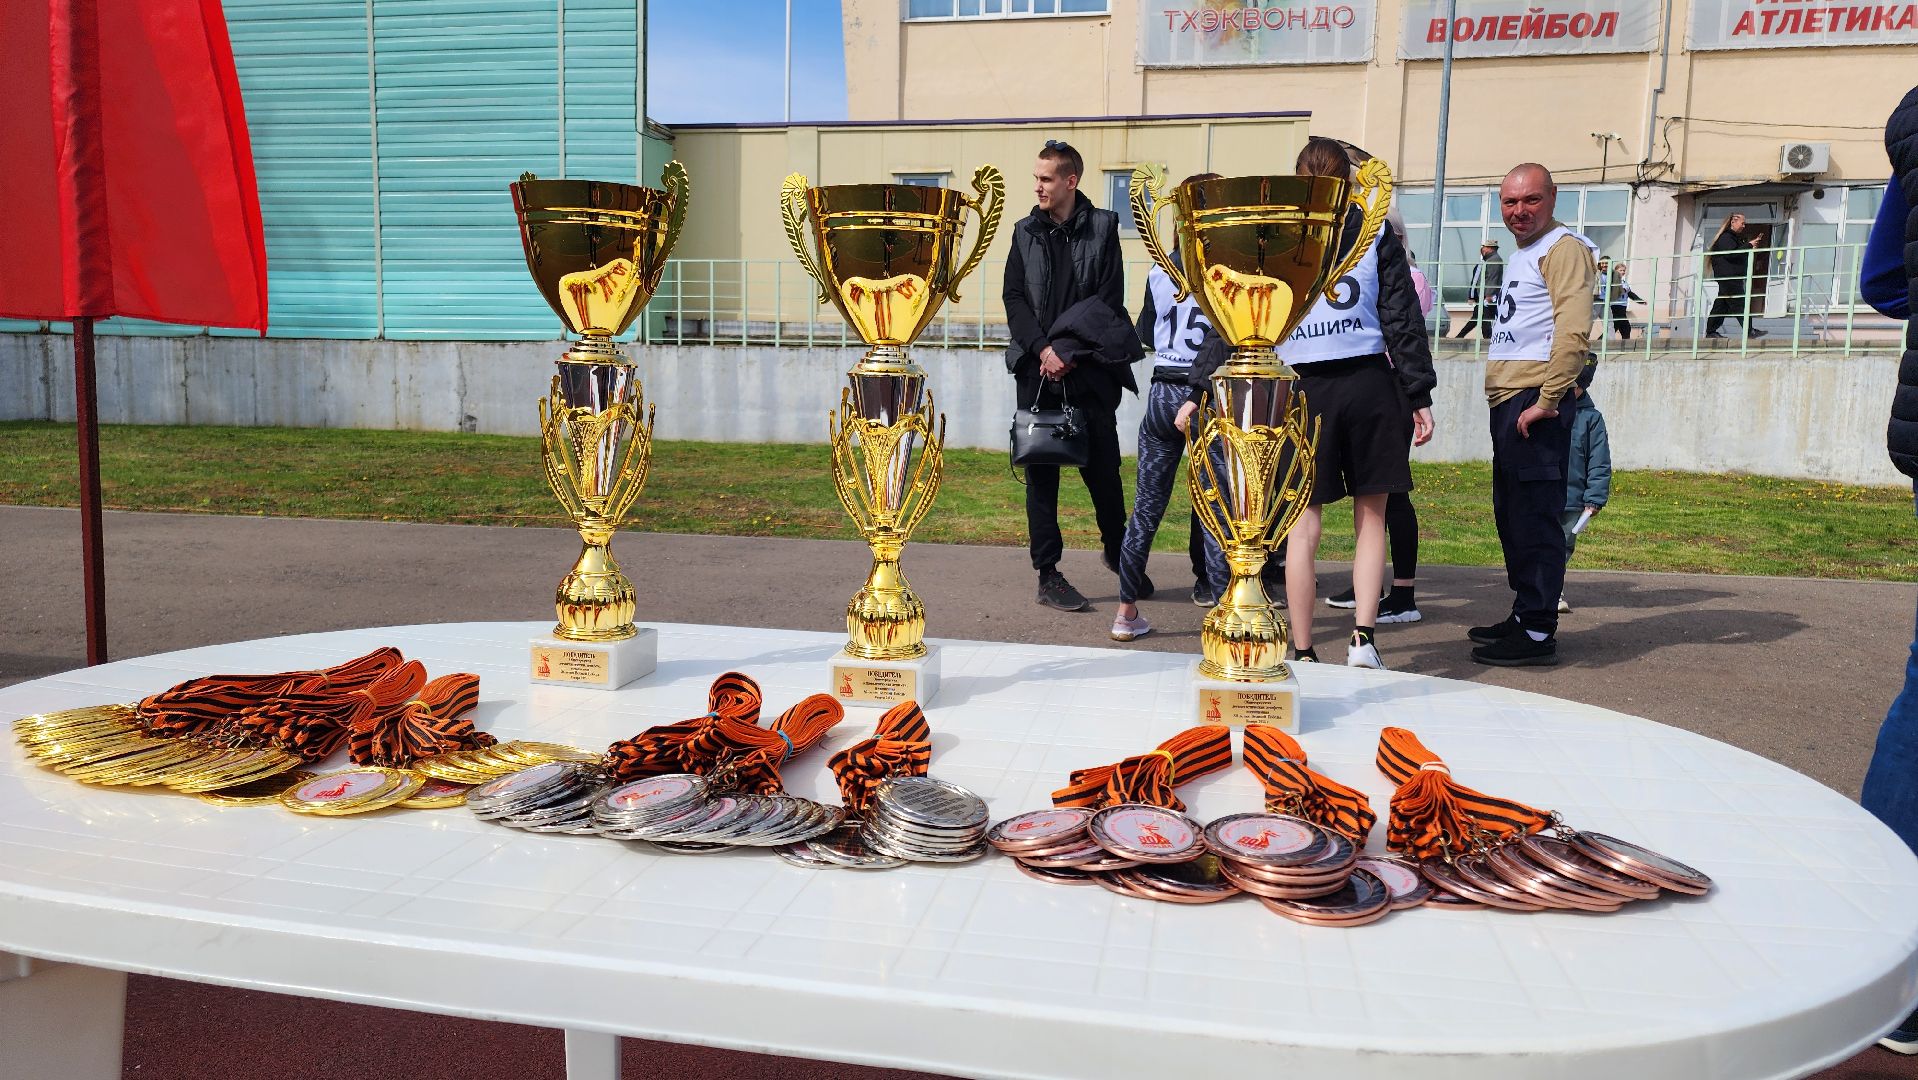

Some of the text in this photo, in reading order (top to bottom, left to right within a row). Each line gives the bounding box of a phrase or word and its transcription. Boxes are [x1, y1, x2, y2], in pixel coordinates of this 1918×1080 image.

[1164, 6, 1356, 32] ТХЭКВОНДО
[1426, 8, 1620, 43] ВОЛЕЙБОЛ
[1732, 4, 1918, 36] АТЛЕТИКА
[1497, 280, 1520, 324] 5
[1163, 306, 1212, 351] 15
